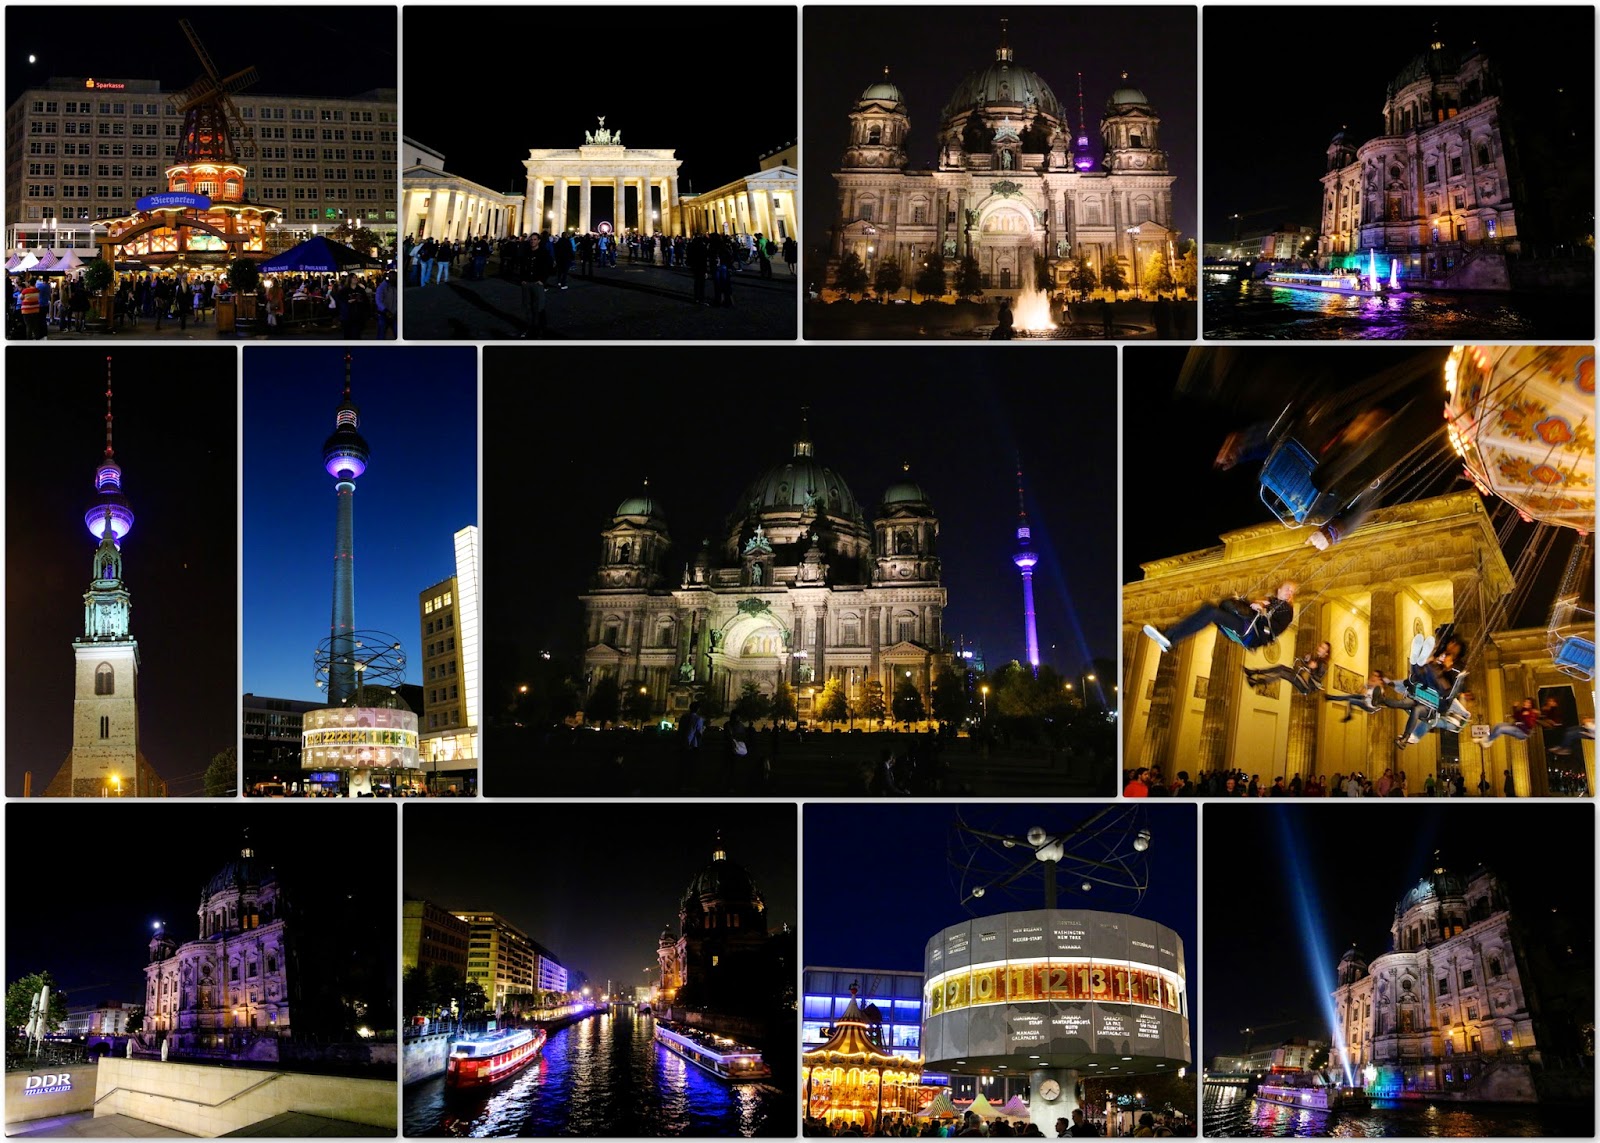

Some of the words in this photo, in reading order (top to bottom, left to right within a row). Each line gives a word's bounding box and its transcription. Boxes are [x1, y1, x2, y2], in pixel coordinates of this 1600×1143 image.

[150, 196, 196, 205] Biergarten
[324, 731, 335, 743] 22
[337, 731, 350, 742] 23
[352, 731, 366, 743] 24
[946, 981, 960, 1005] 9
[971, 974, 993, 1000] 10
[1002, 970, 1024, 996] 11
[1038, 969, 1068, 993] 12
[1077, 969, 1106, 993] 13
[1115, 972, 1138, 997] 14
[26, 1073, 71, 1089] DDR
[25, 1085, 71, 1096] museum
